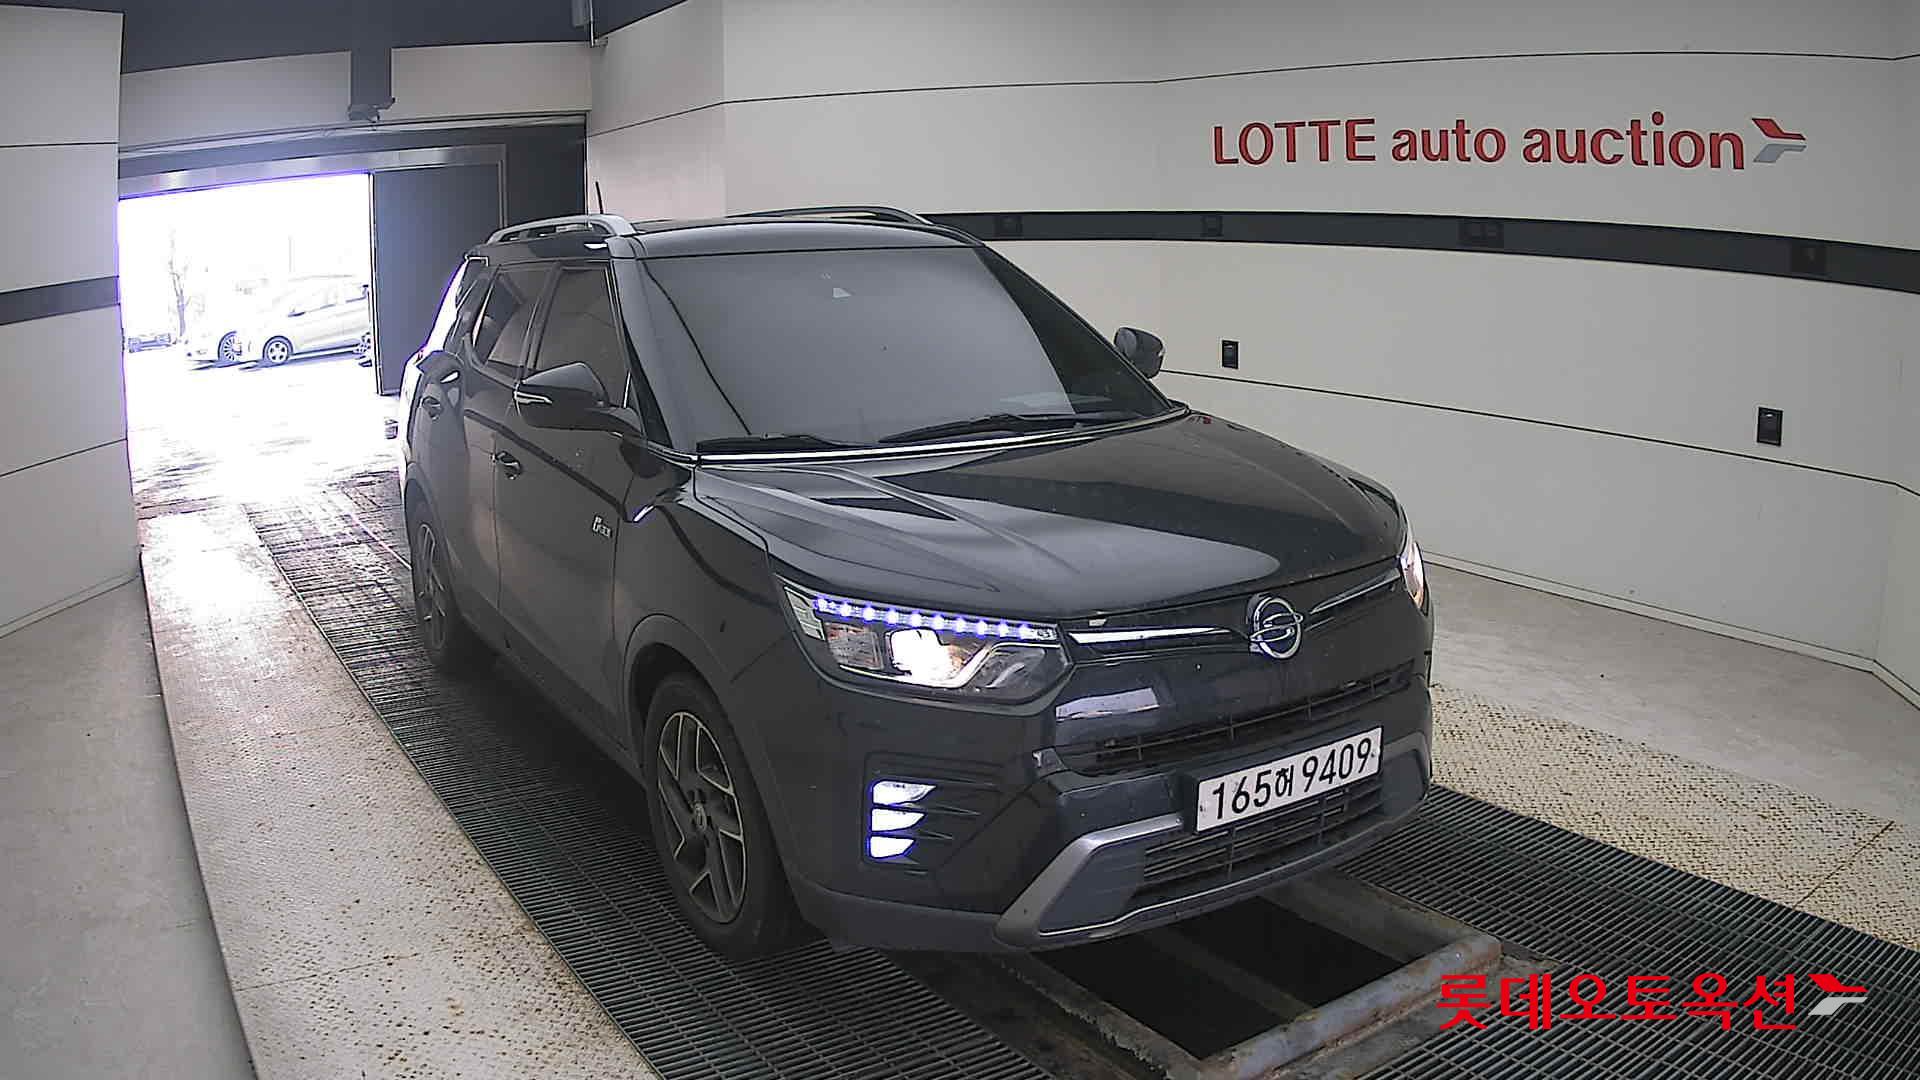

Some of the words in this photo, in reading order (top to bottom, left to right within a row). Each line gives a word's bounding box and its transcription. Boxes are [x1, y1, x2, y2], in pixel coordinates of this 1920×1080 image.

[1213, 118, 1377, 165] LOTTE
[1391, 119, 1508, 164] auto
[1522, 111, 1746, 170] auction
[1212, 764, 1295, 820] 165허
[1301, 737, 1373, 793] 9409
